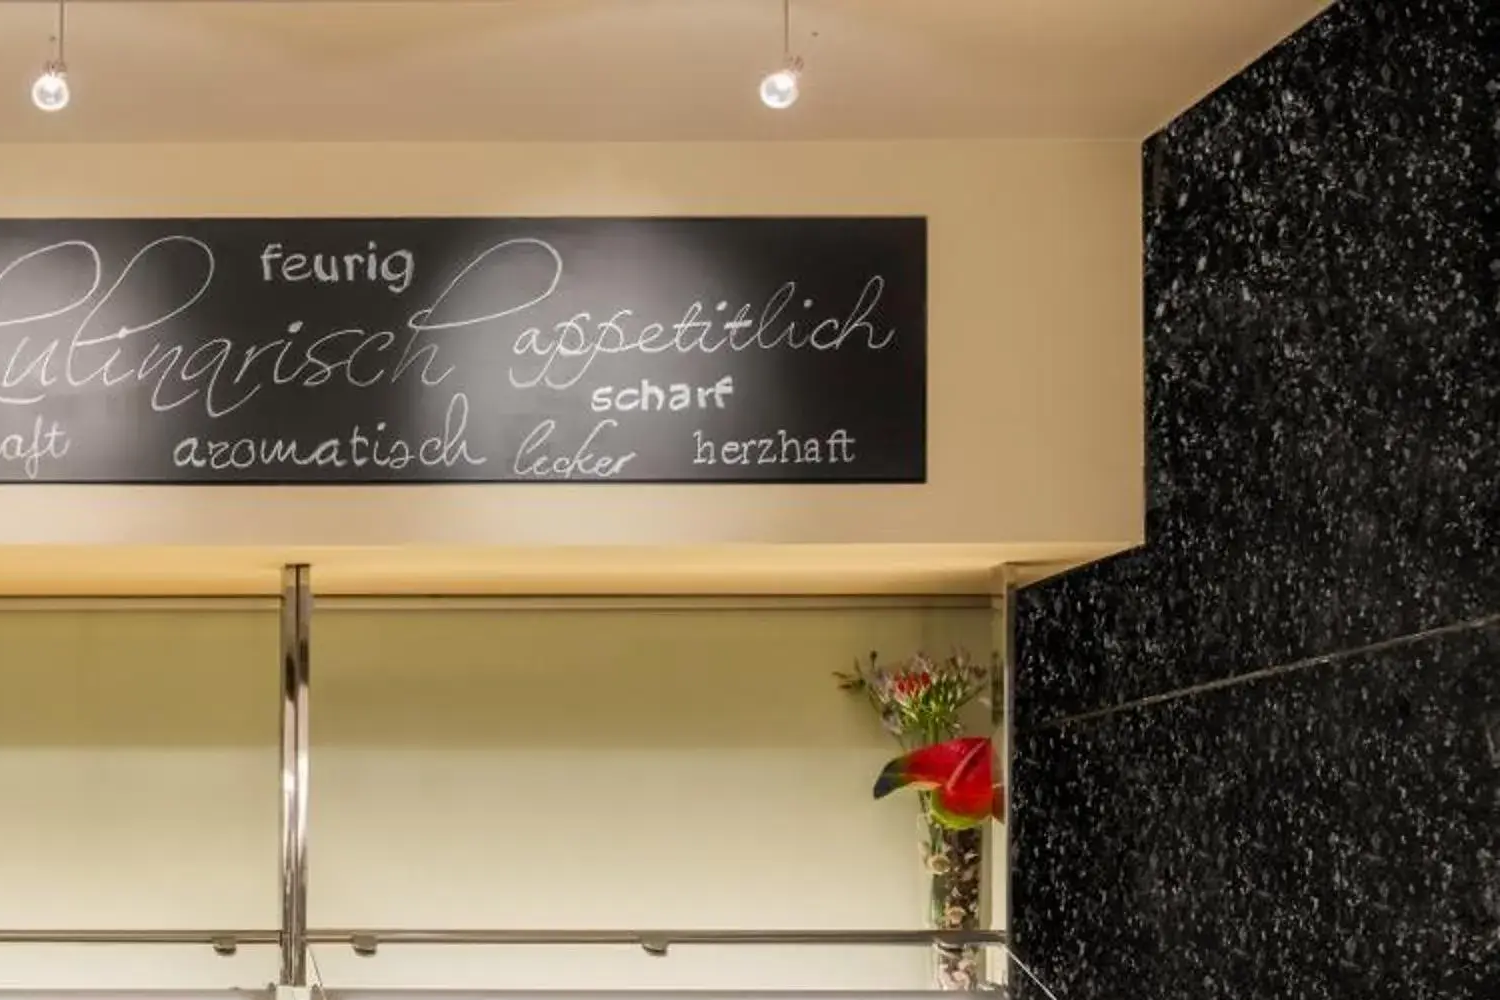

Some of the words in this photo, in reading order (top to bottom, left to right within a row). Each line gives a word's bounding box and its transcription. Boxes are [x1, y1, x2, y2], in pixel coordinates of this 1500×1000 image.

[259, 241, 414, 292] feurig
[508, 274, 896, 390] appetitlich
[590, 376, 734, 412] scharf
[173, 392, 487, 470] aromatisch
[512, 419, 638, 478] lecker
[691, 428, 856, 465] herzhaft
